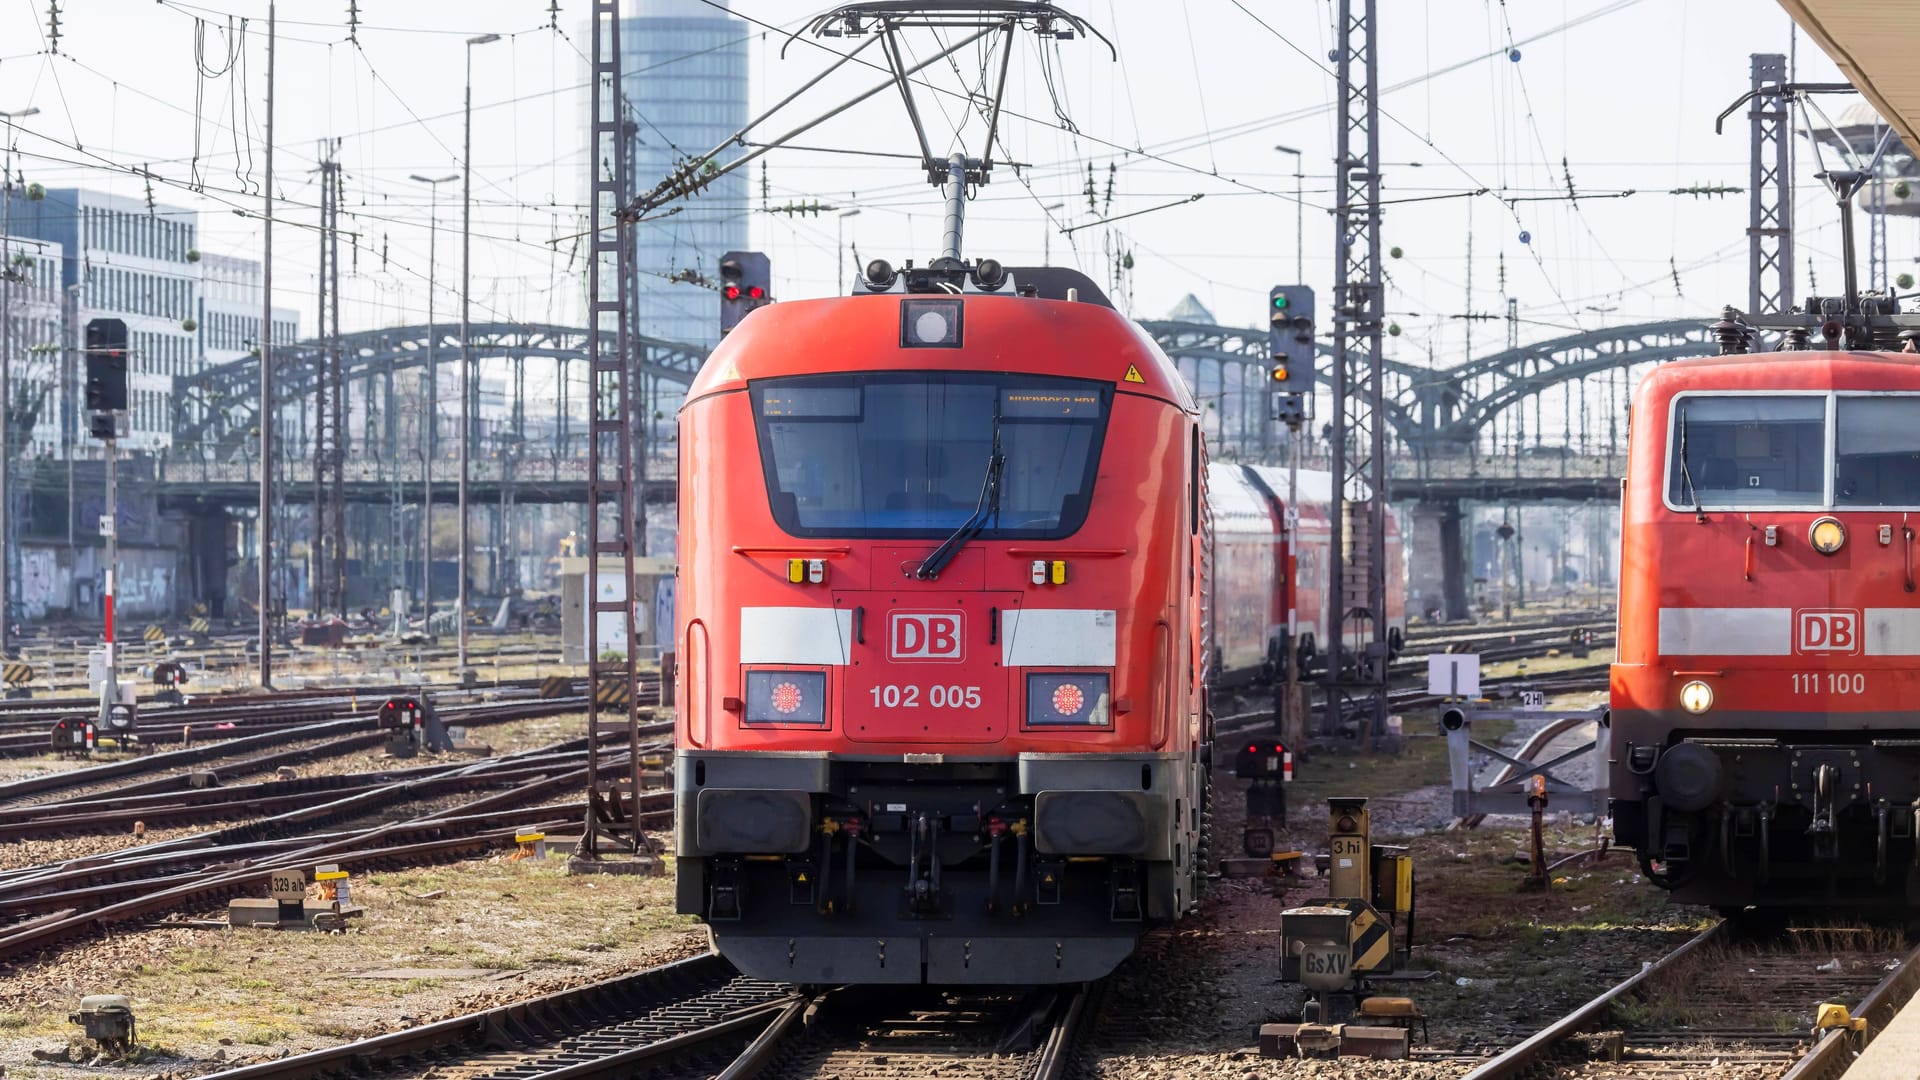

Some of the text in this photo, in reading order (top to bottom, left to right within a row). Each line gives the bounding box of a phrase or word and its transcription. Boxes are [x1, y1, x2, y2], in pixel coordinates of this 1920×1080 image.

[895, 616, 958, 656] DB
[1803, 615, 1853, 648] DB
[1791, 672, 1865, 695] 111 100
[869, 684, 982, 709] 102 005
[1333, 840, 1360, 854] 3 hi
[273, 877, 305, 894] 329 a/b
